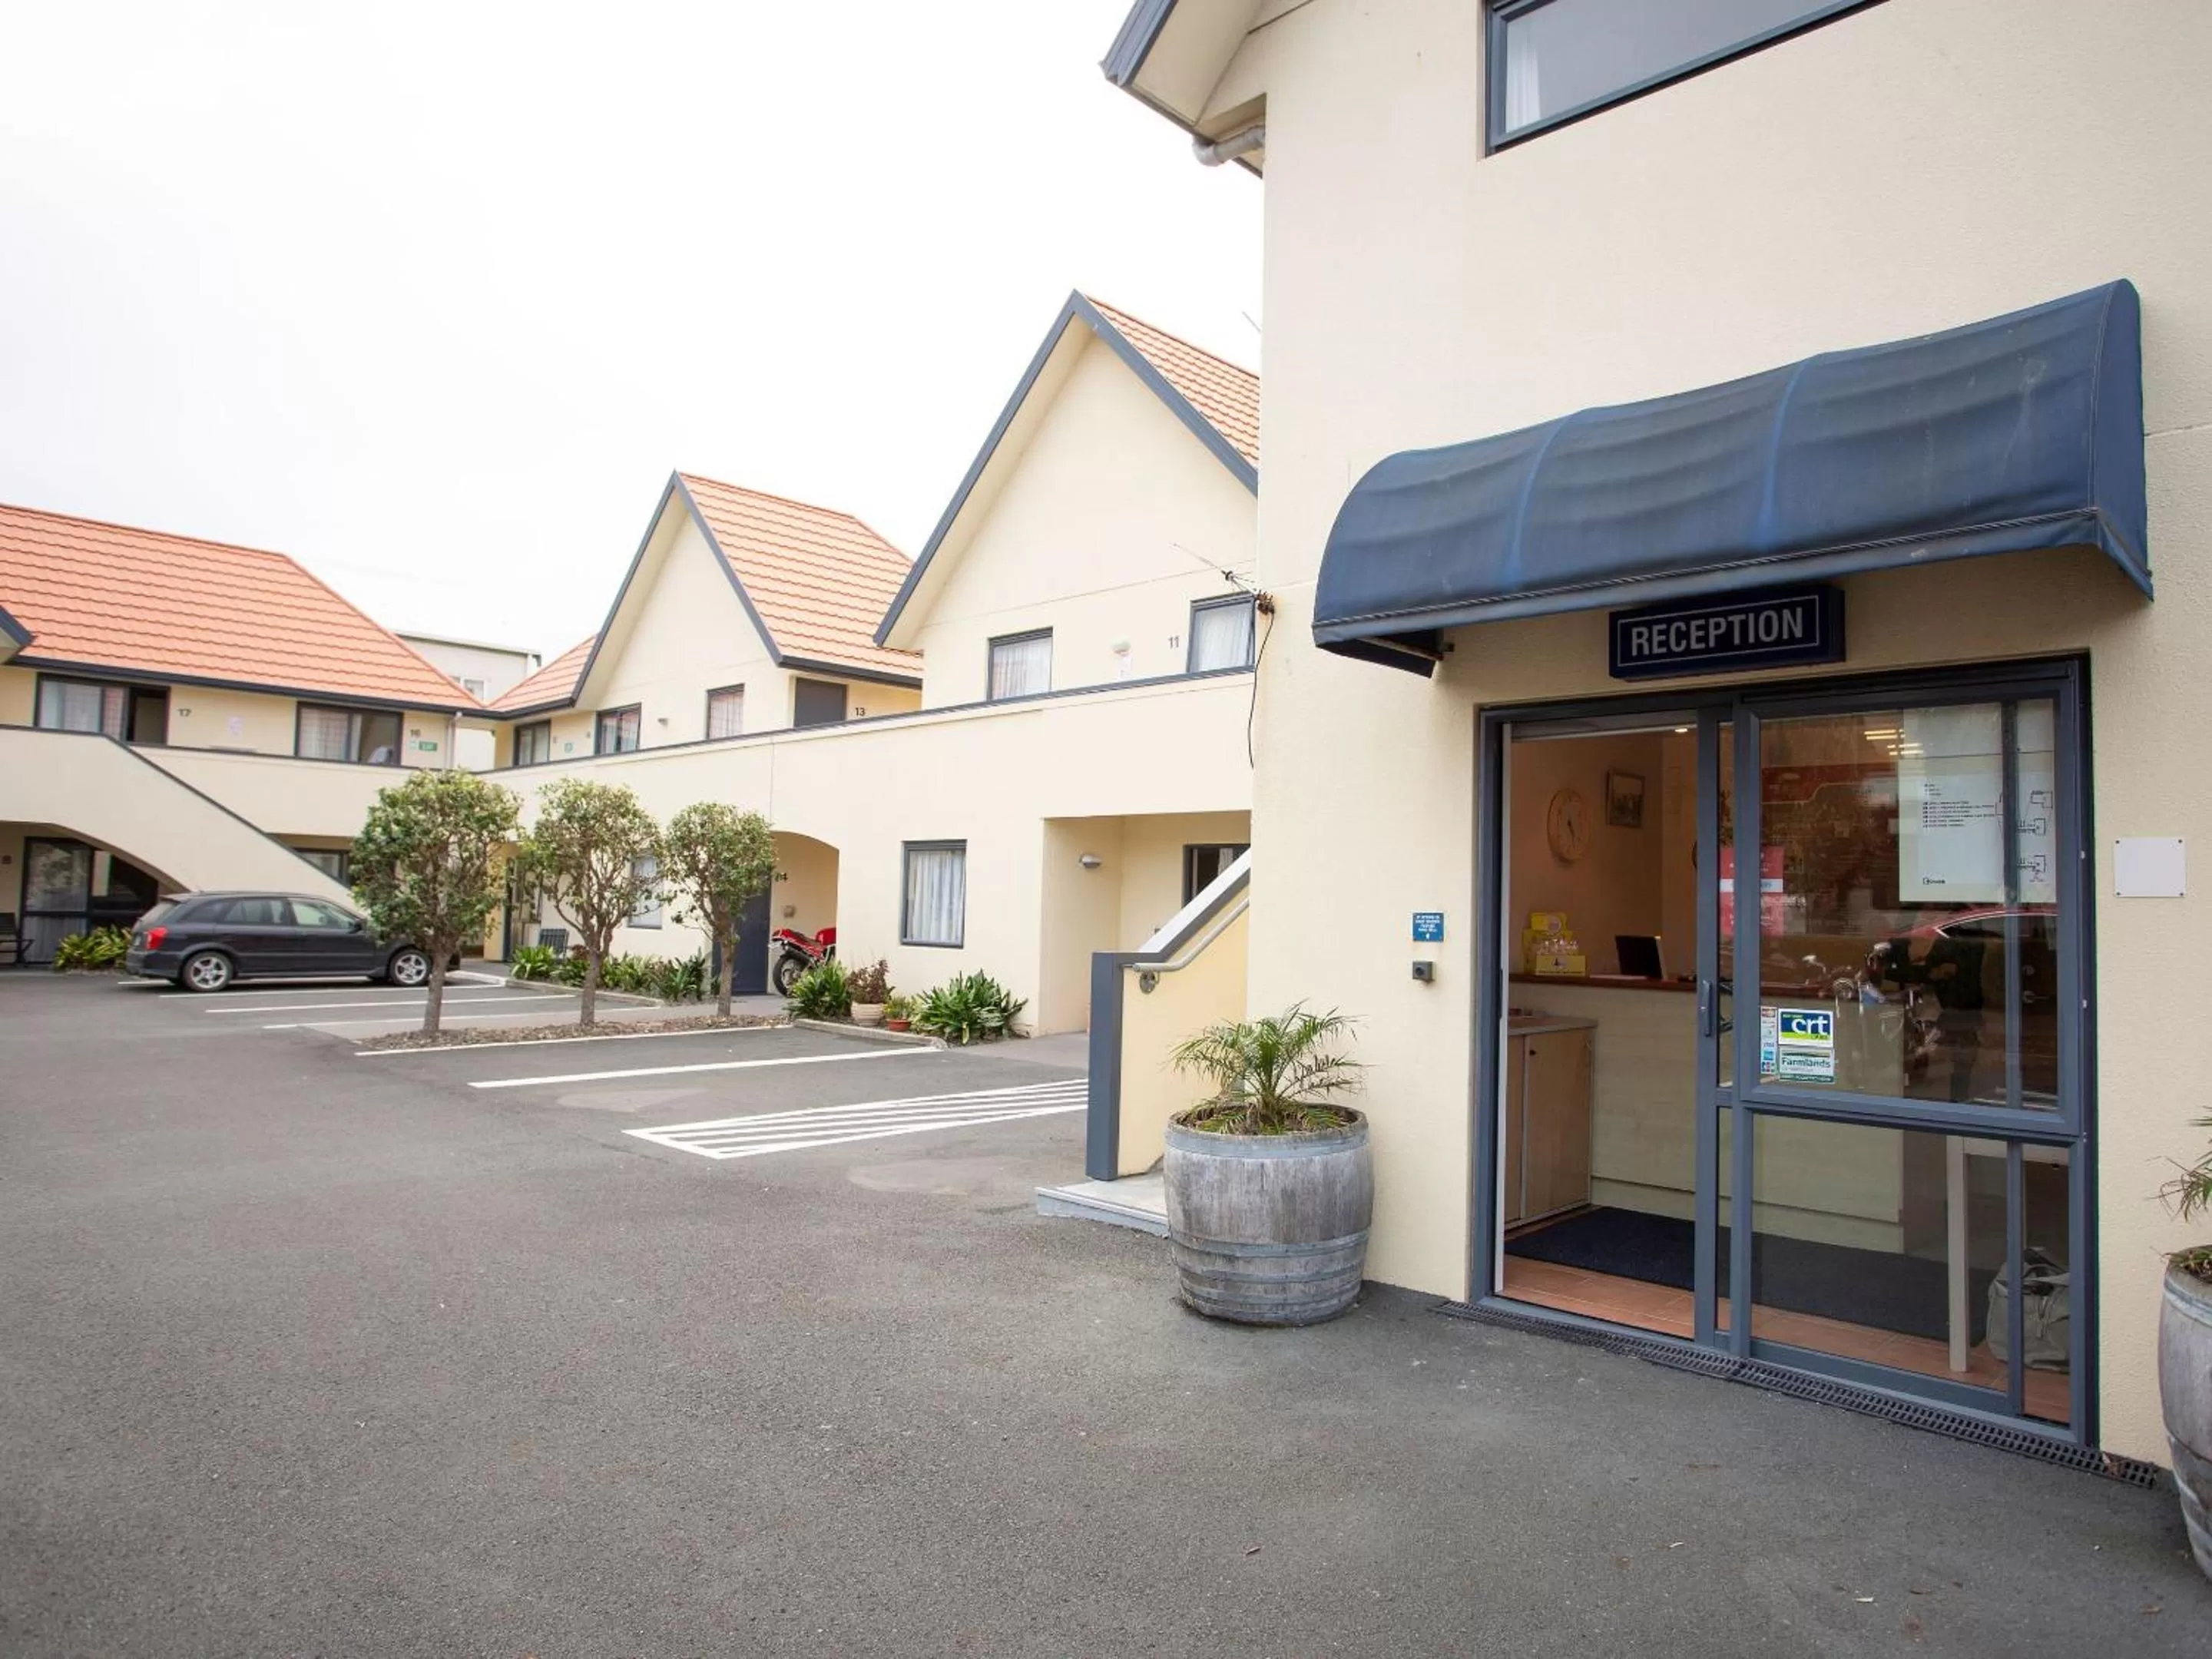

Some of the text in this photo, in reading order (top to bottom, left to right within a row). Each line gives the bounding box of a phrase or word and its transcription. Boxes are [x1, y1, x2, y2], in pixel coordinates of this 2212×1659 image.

[1631, 607, 1803, 656] RECEPTION
[1167, 636, 1180, 649] 11
[177, 708, 192, 717] 17
[856, 707, 865, 717] 13
[1791, 1015, 1828, 1035] crt
[1781, 1057, 1832, 1068] Farmlands
